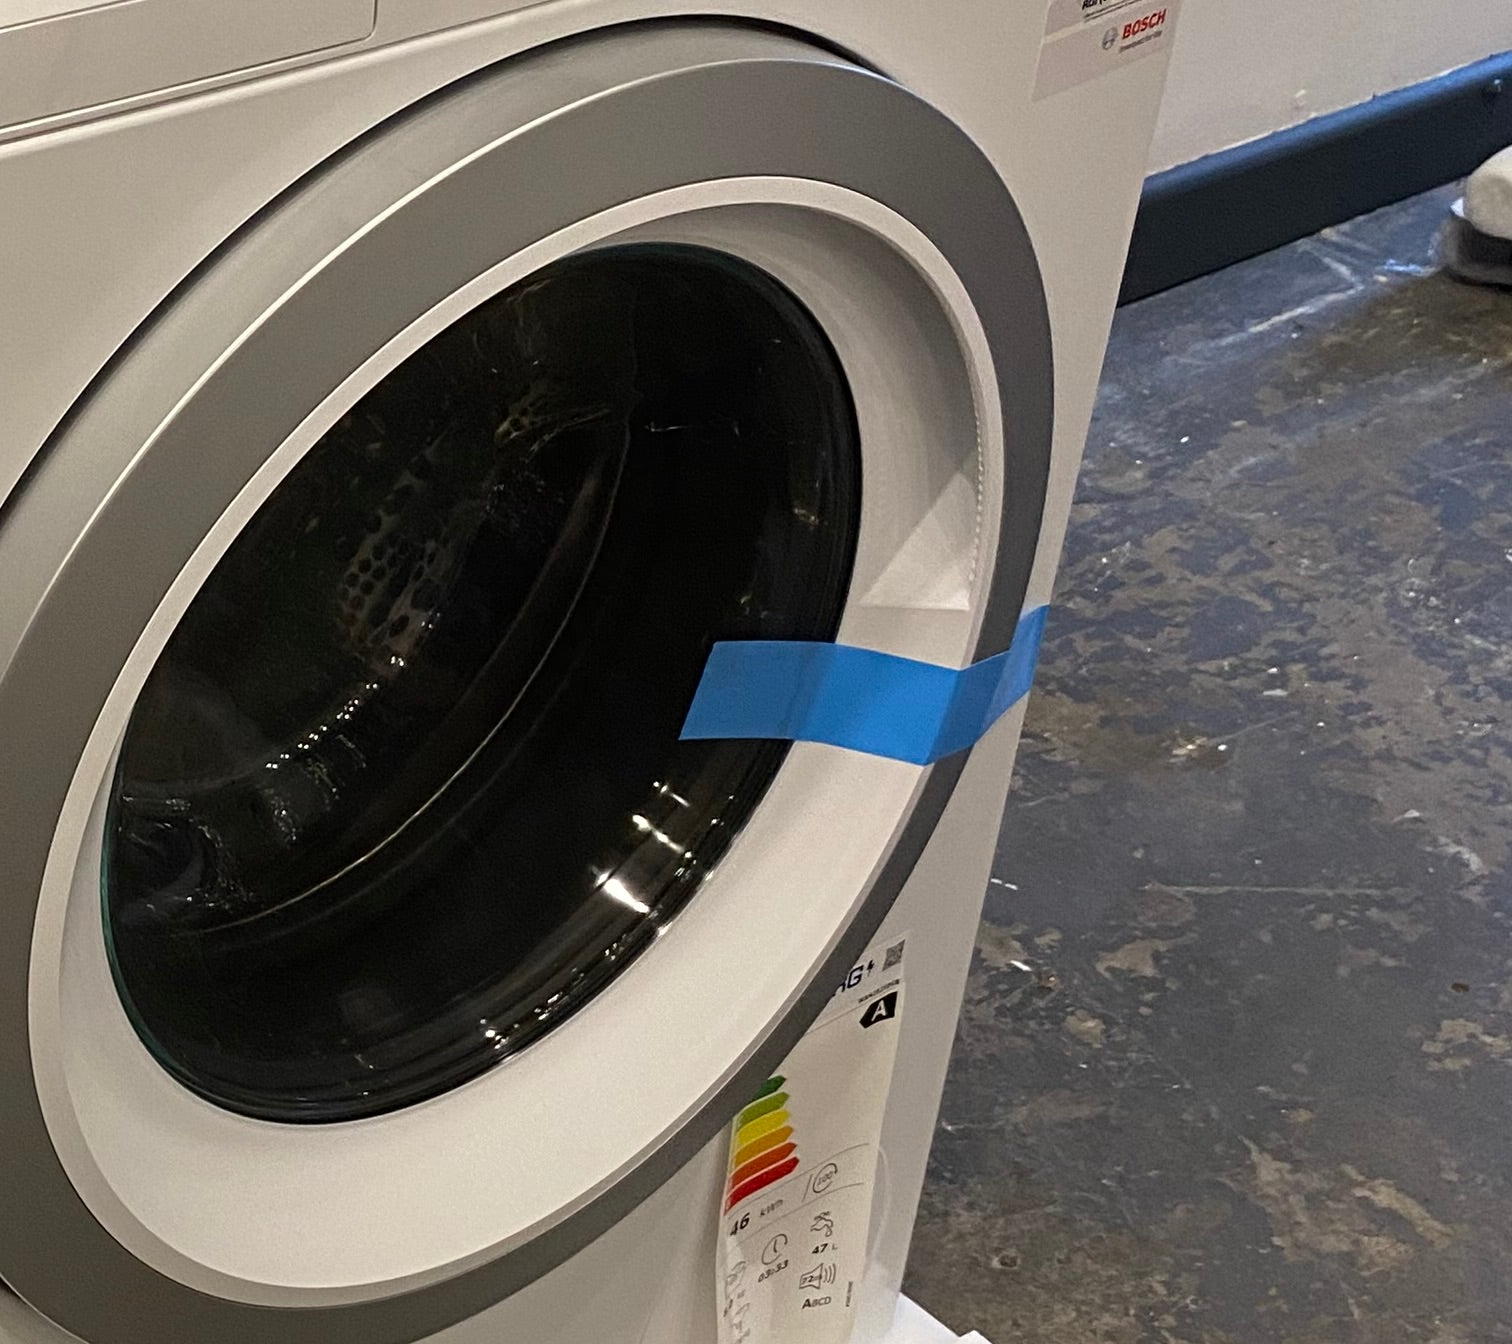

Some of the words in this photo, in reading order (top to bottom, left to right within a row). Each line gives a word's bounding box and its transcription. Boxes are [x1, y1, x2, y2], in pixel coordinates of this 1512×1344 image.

[1122, 9, 1167, 41] BOSCH
[872, 999, 889, 1021] A
[730, 1211, 751, 1238] 46
[811, 1240, 830, 1255] 47
